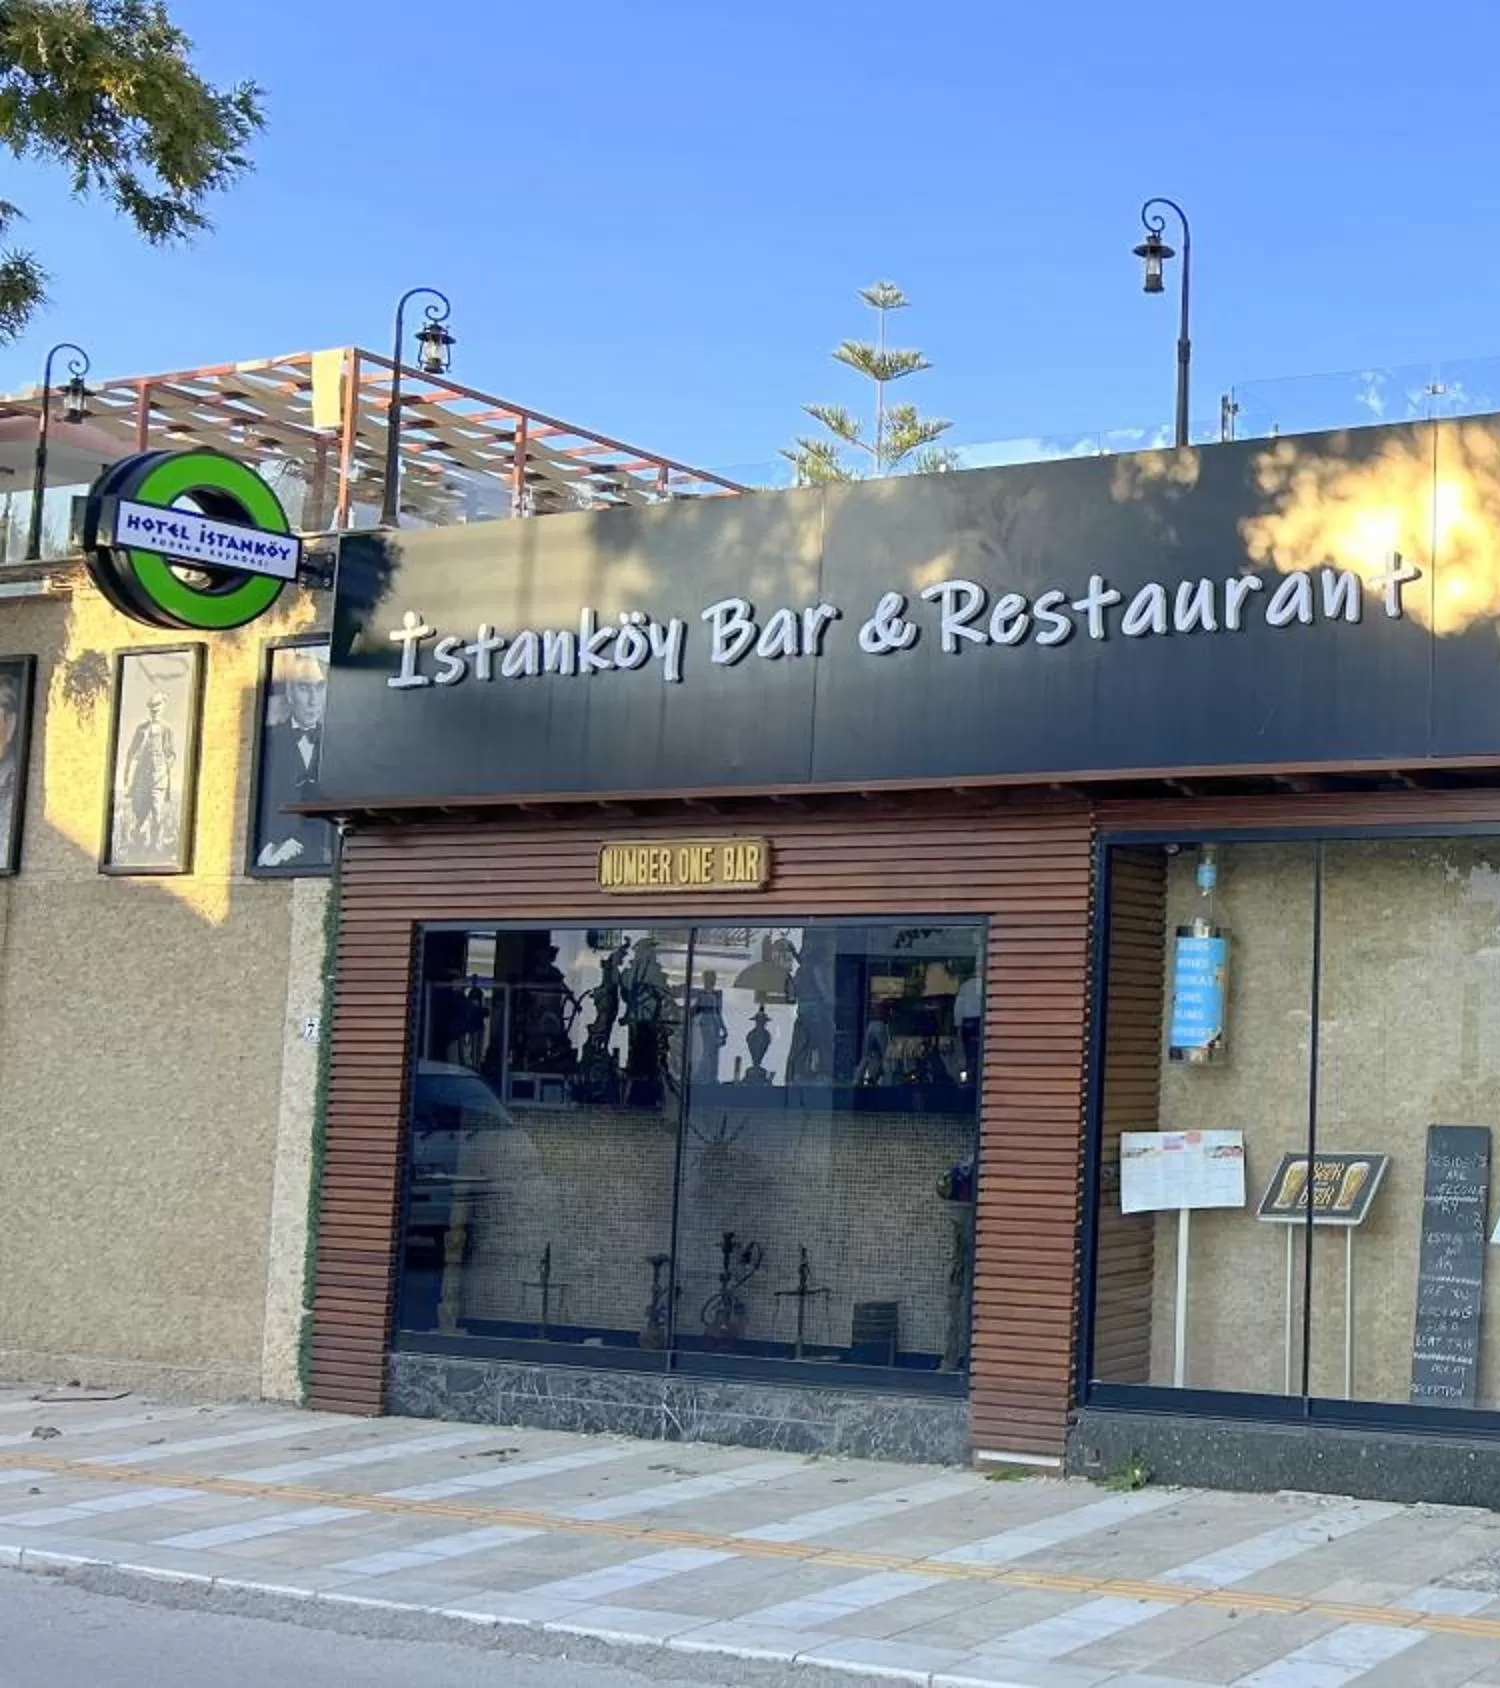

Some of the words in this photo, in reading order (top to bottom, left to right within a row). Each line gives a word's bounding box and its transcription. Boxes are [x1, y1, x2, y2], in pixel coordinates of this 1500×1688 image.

[127, 514, 190, 540] HOTEL
[200, 524, 290, 560] İSTANKÖY
[387, 607, 688, 689] İstanköy
[701, 597, 842, 668] Bar
[858, 591, 917, 655] &
[920, 550, 1424, 654] Restaurant
[601, 848, 672, 886] NUMBER
[679, 847, 714, 884] ONE
[723, 845, 762, 882] BAR
